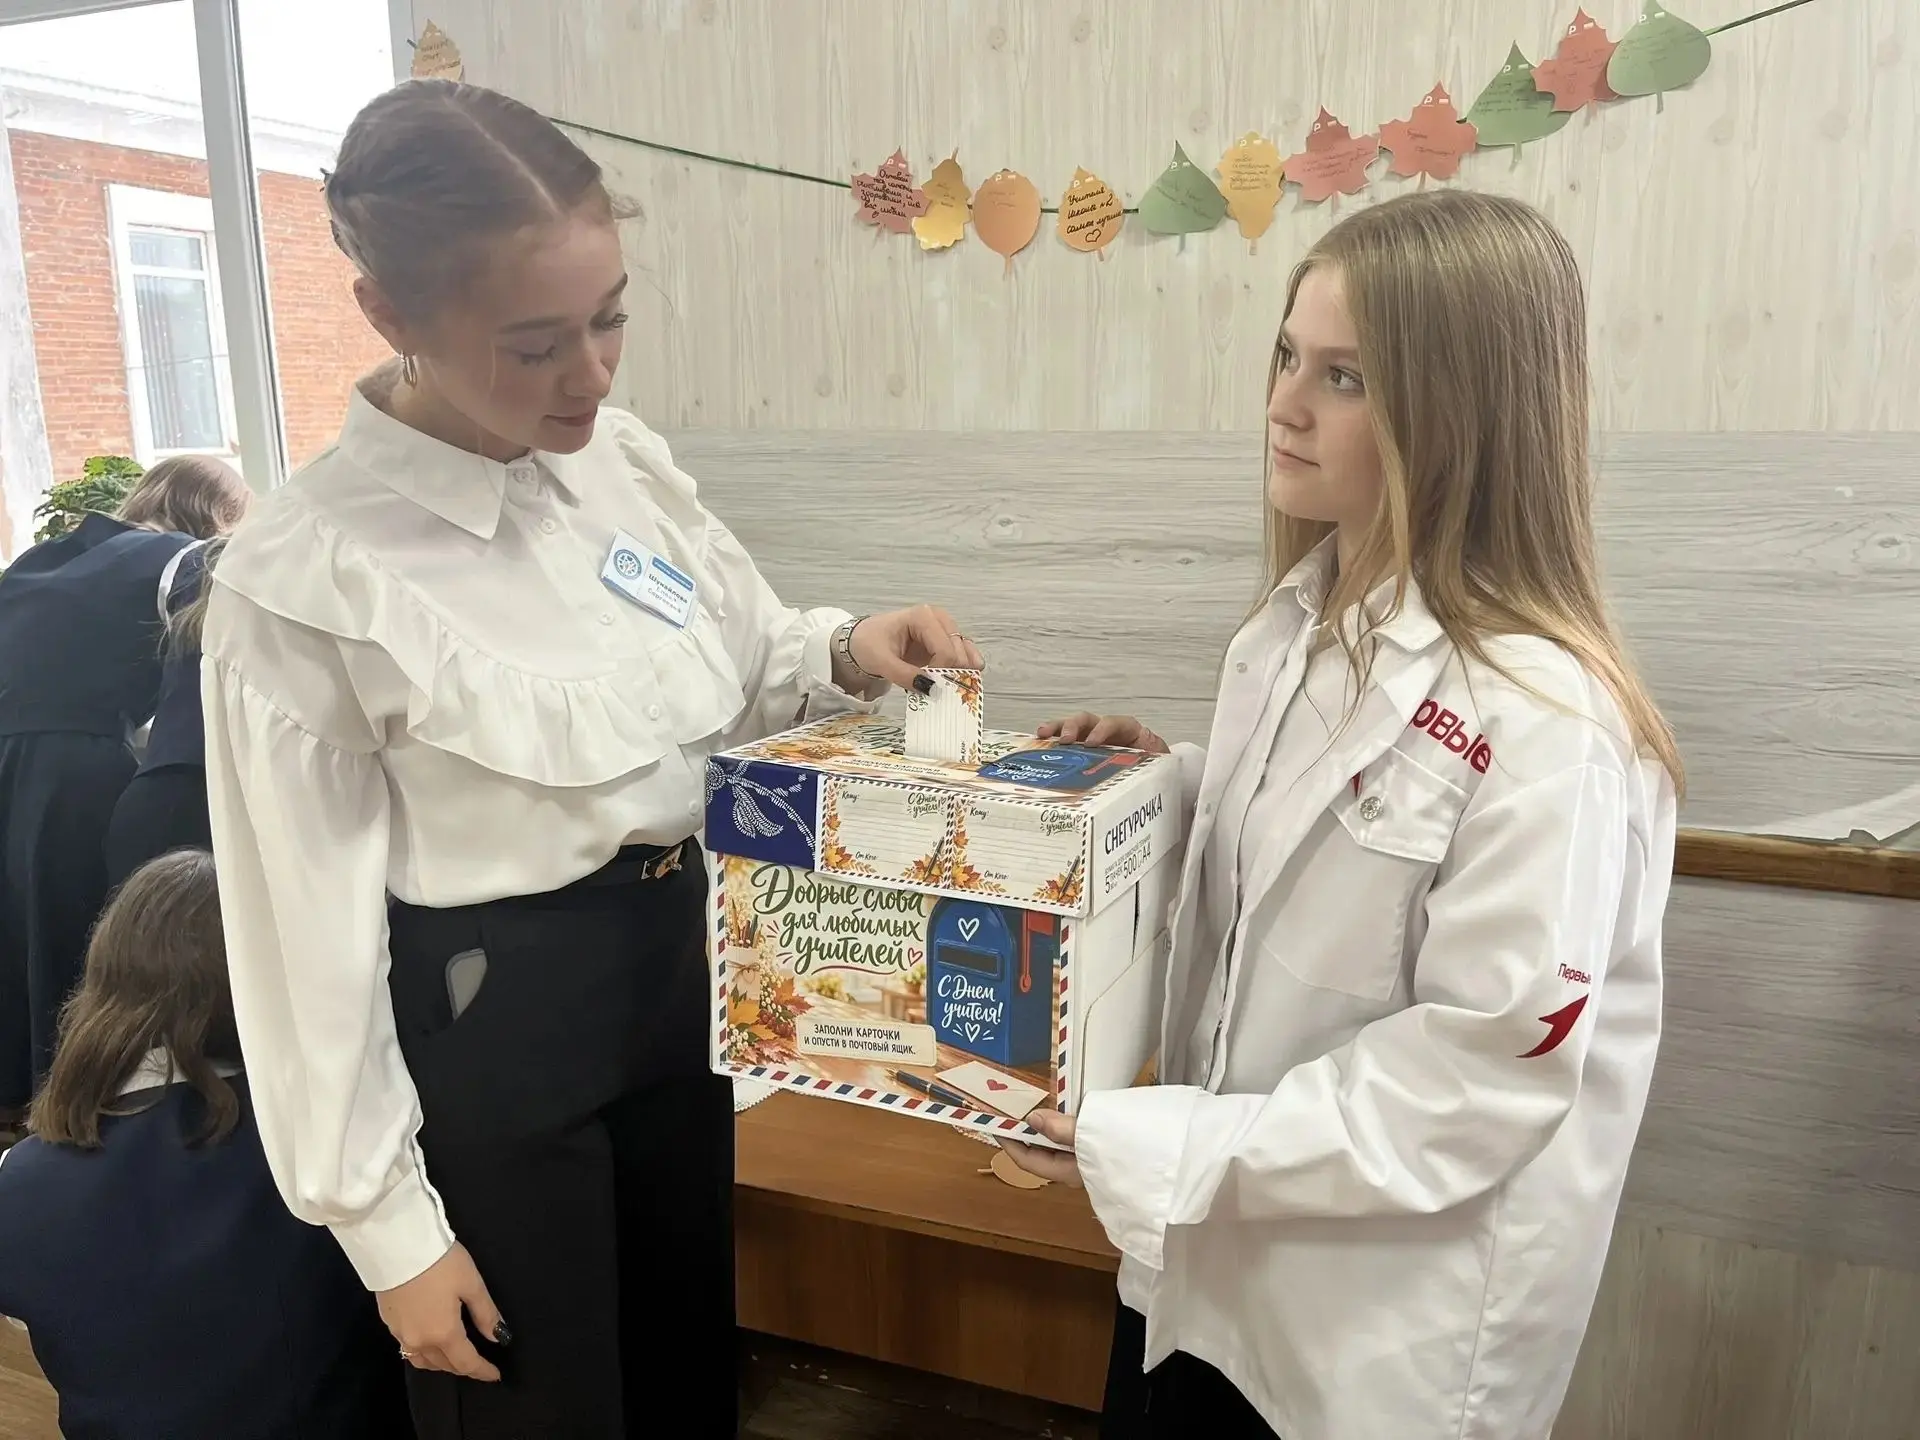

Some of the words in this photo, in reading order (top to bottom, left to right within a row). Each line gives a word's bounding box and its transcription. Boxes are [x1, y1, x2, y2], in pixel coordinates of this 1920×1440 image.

[969, 807, 990, 820] Кому:
[1105, 793, 1163, 855] СНЕГУРОЧКА
[750, 863, 860, 915] Добрые
[863, 888, 926, 918] слова
[780, 912, 819, 948] для
[822, 908, 924, 942] любимых
[794, 935, 908, 975] учителей
[938, 975, 952, 998] С
[952, 975, 996, 1002] Днем
[941, 1001, 1004, 1029] учителя!
[804, 1036, 810, 1045] И
[812, 1037, 840, 1048] ОПУСТИ
[842, 1040, 847, 1048] В
[849, 1040, 889, 1052] ПОЧТОВЫЙ
[892, 1044, 916, 1055] ЯЩИК.
[814, 1024, 853, 1036] ЗАПОЛНИ
[856, 1028, 900, 1040] КАРТОЧКИ
